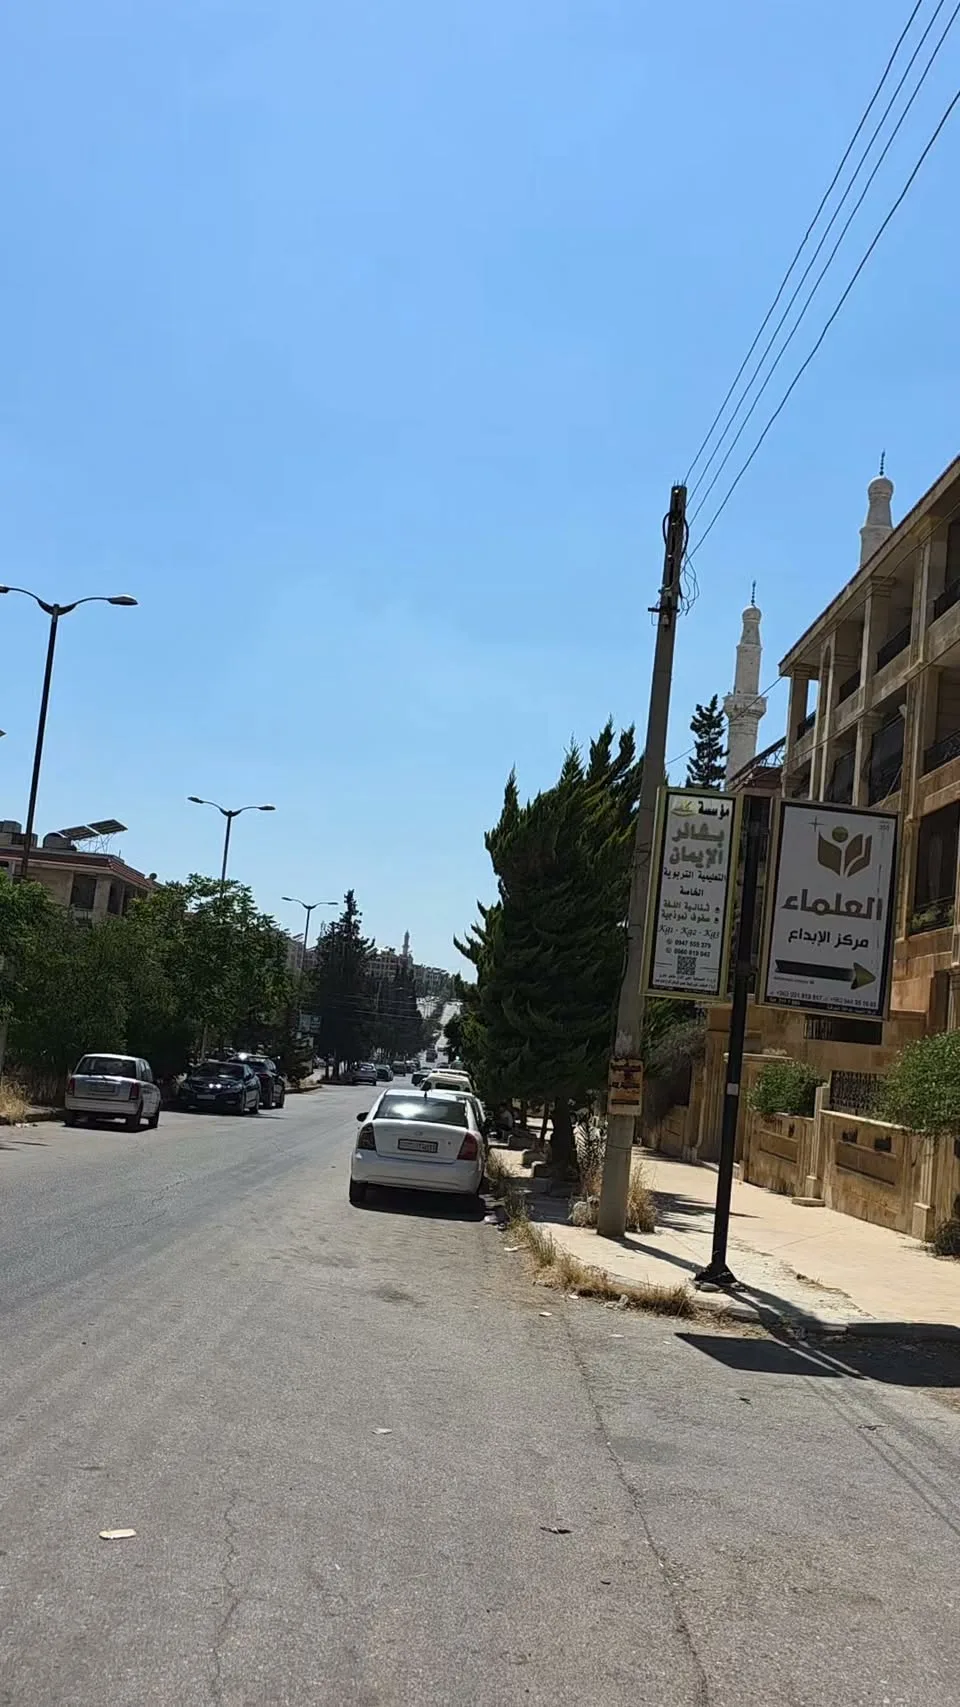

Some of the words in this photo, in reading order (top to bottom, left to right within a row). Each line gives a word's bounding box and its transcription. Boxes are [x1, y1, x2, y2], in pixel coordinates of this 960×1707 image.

[698, 801, 730, 820] مؤسسة
[669, 846, 723, 869] الإيمان
[663, 866, 694, 880] التربوية
[698, 870, 727, 883] التعليمية
[680, 885, 704, 897] الخاصة
[782, 888, 882, 920] العلماء
[788, 928, 830, 946] الإبداع
[834, 932, 869, 950] مركز
